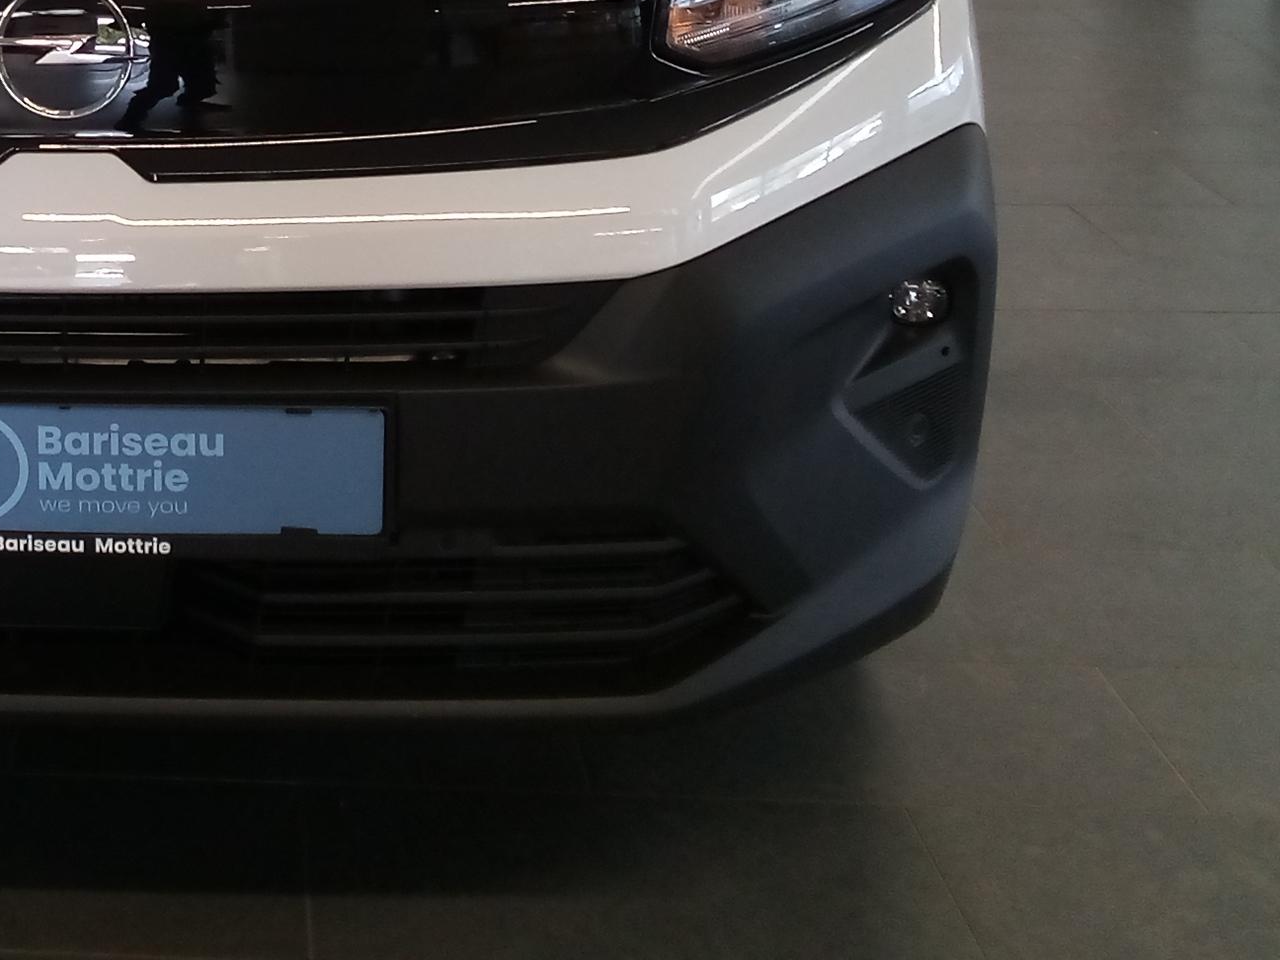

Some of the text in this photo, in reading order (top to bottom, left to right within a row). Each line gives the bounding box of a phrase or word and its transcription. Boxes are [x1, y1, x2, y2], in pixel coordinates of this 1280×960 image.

[37, 423, 225, 458] Bariseau
[37, 460, 190, 493] Mottrie
[39, 499, 188, 518] we move you
[95, 537, 172, 555] Mottrie
